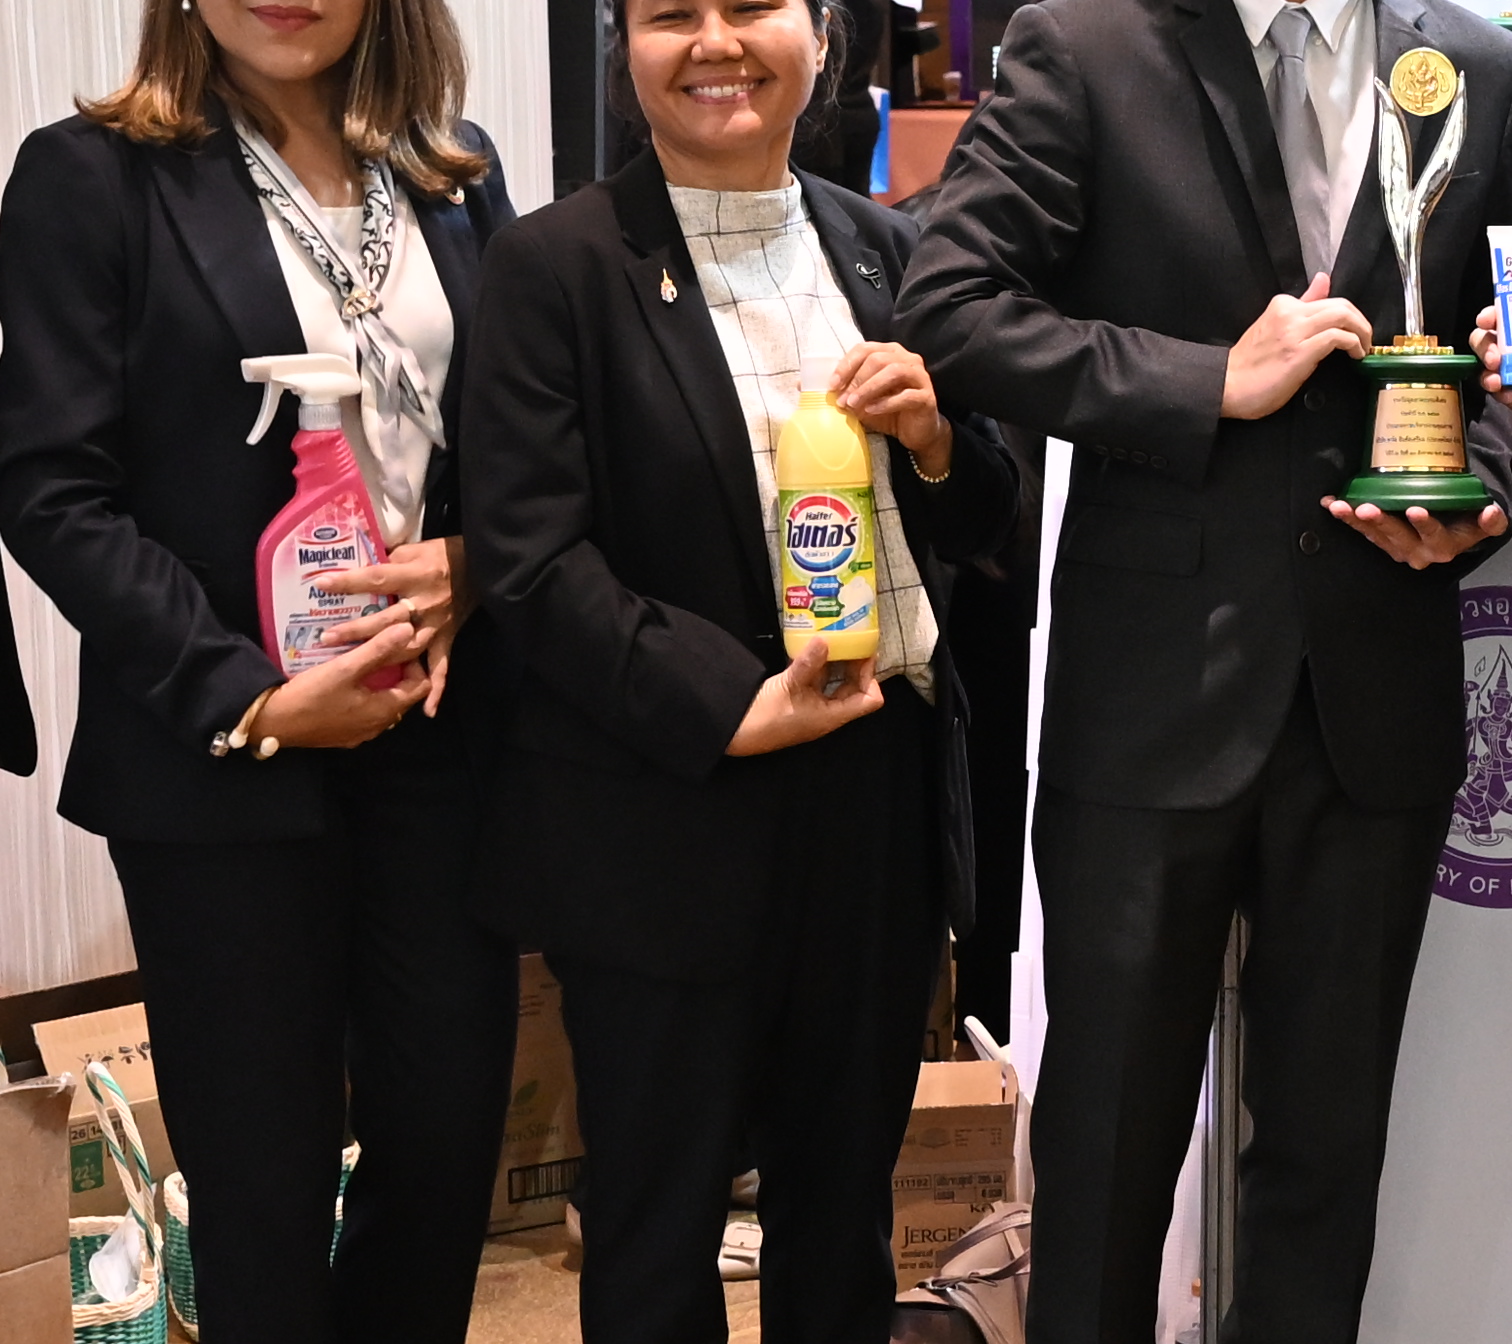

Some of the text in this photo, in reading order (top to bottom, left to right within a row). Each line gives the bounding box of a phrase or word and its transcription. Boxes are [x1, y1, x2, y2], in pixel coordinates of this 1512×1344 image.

[786, 516, 859, 549] ไฮเตอร์
[299, 545, 356, 566] Magiclean
[318, 596, 345, 608] SPRAY
[1469, 874, 1500, 896] OF
